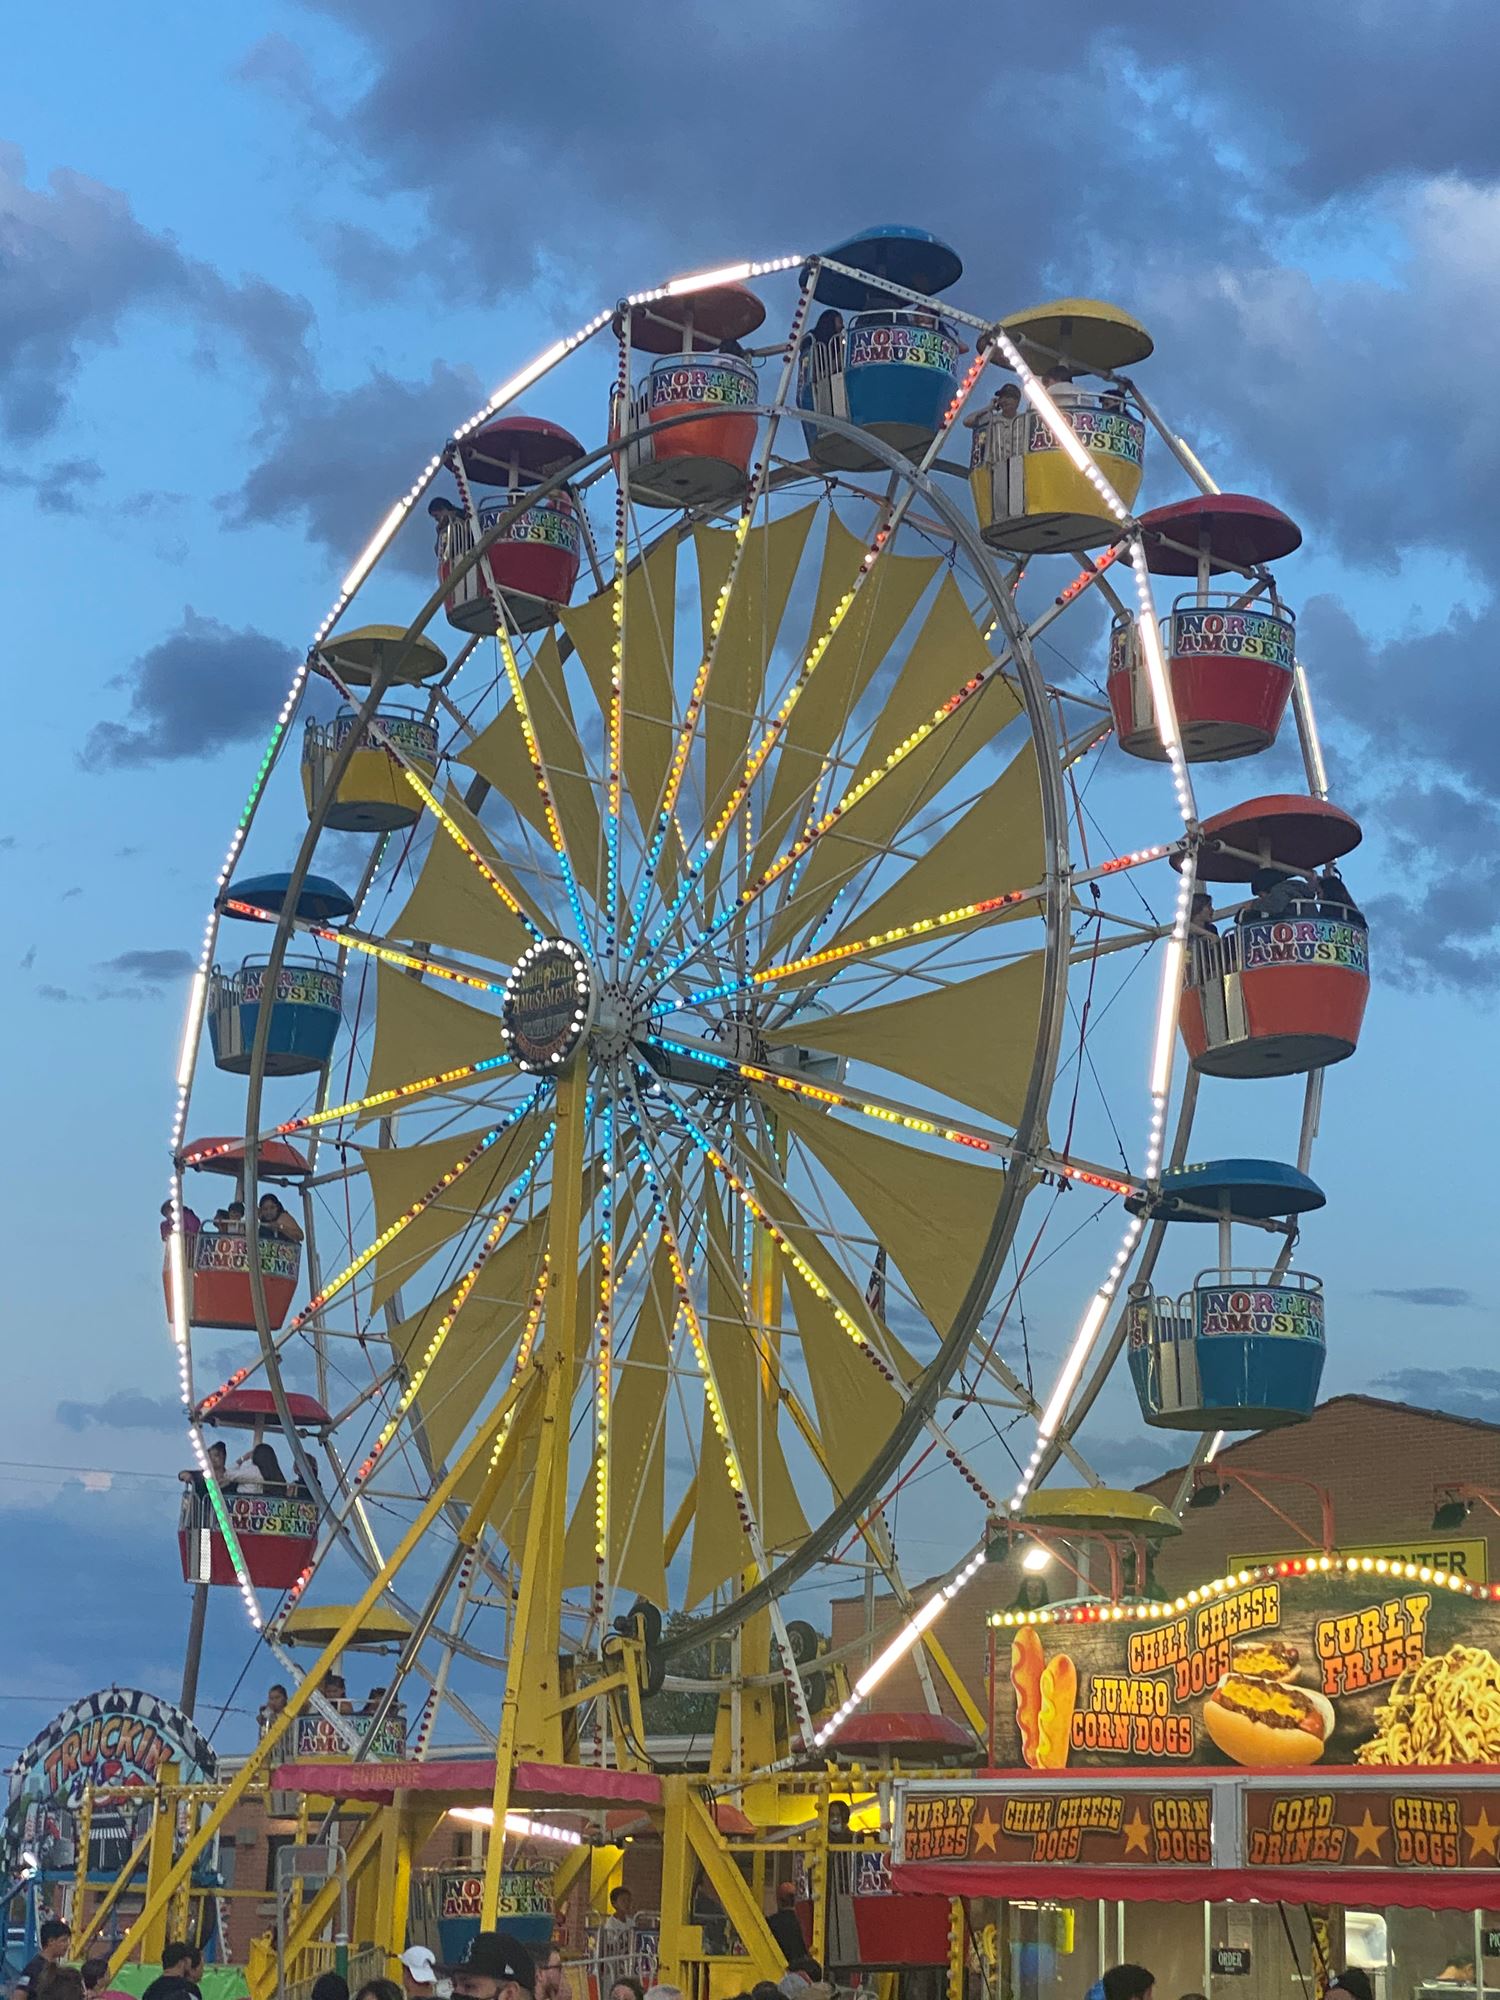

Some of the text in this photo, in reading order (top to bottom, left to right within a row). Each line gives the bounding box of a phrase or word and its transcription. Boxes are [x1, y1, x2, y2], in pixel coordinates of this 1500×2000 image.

[855, 328, 942, 353] NORTH
[656, 369, 740, 392] NORTH
[1183, 614, 1282, 645] NORTH
[1249, 921, 1355, 948] NORTH
[246, 970, 321, 988] NRTH
[201, 1238, 279, 1256] NORH
[1206, 1292, 1312, 1318] NORTH
[1129, 1584, 1279, 1675] CHILI CHEESE
[1317, 1595, 1430, 1658] CURLY
[1175, 1638, 1231, 1700] DOGS
[1322, 1633, 1424, 1696] FRIES
[1092, 1678, 1169, 1717] JUMBO
[1071, 1711, 1193, 1754] CORN DOGS
[44, 1714, 176, 1794] TRUCKIN
[905, 1797, 1210, 1831] CURLY CHILI CHEESE CORN
[1272, 1795, 1334, 1833] COLD
[1393, 1797, 1459, 1834] CHILI
[906, 1826, 1211, 1862] FRIES DOGS DOGS
[1250, 1828, 1345, 1865] DRINKS
[1397, 1830, 1459, 1867] DOGS
[445, 1878, 537, 1898] NOTH
[1218, 1951, 1243, 1968] ORDER
